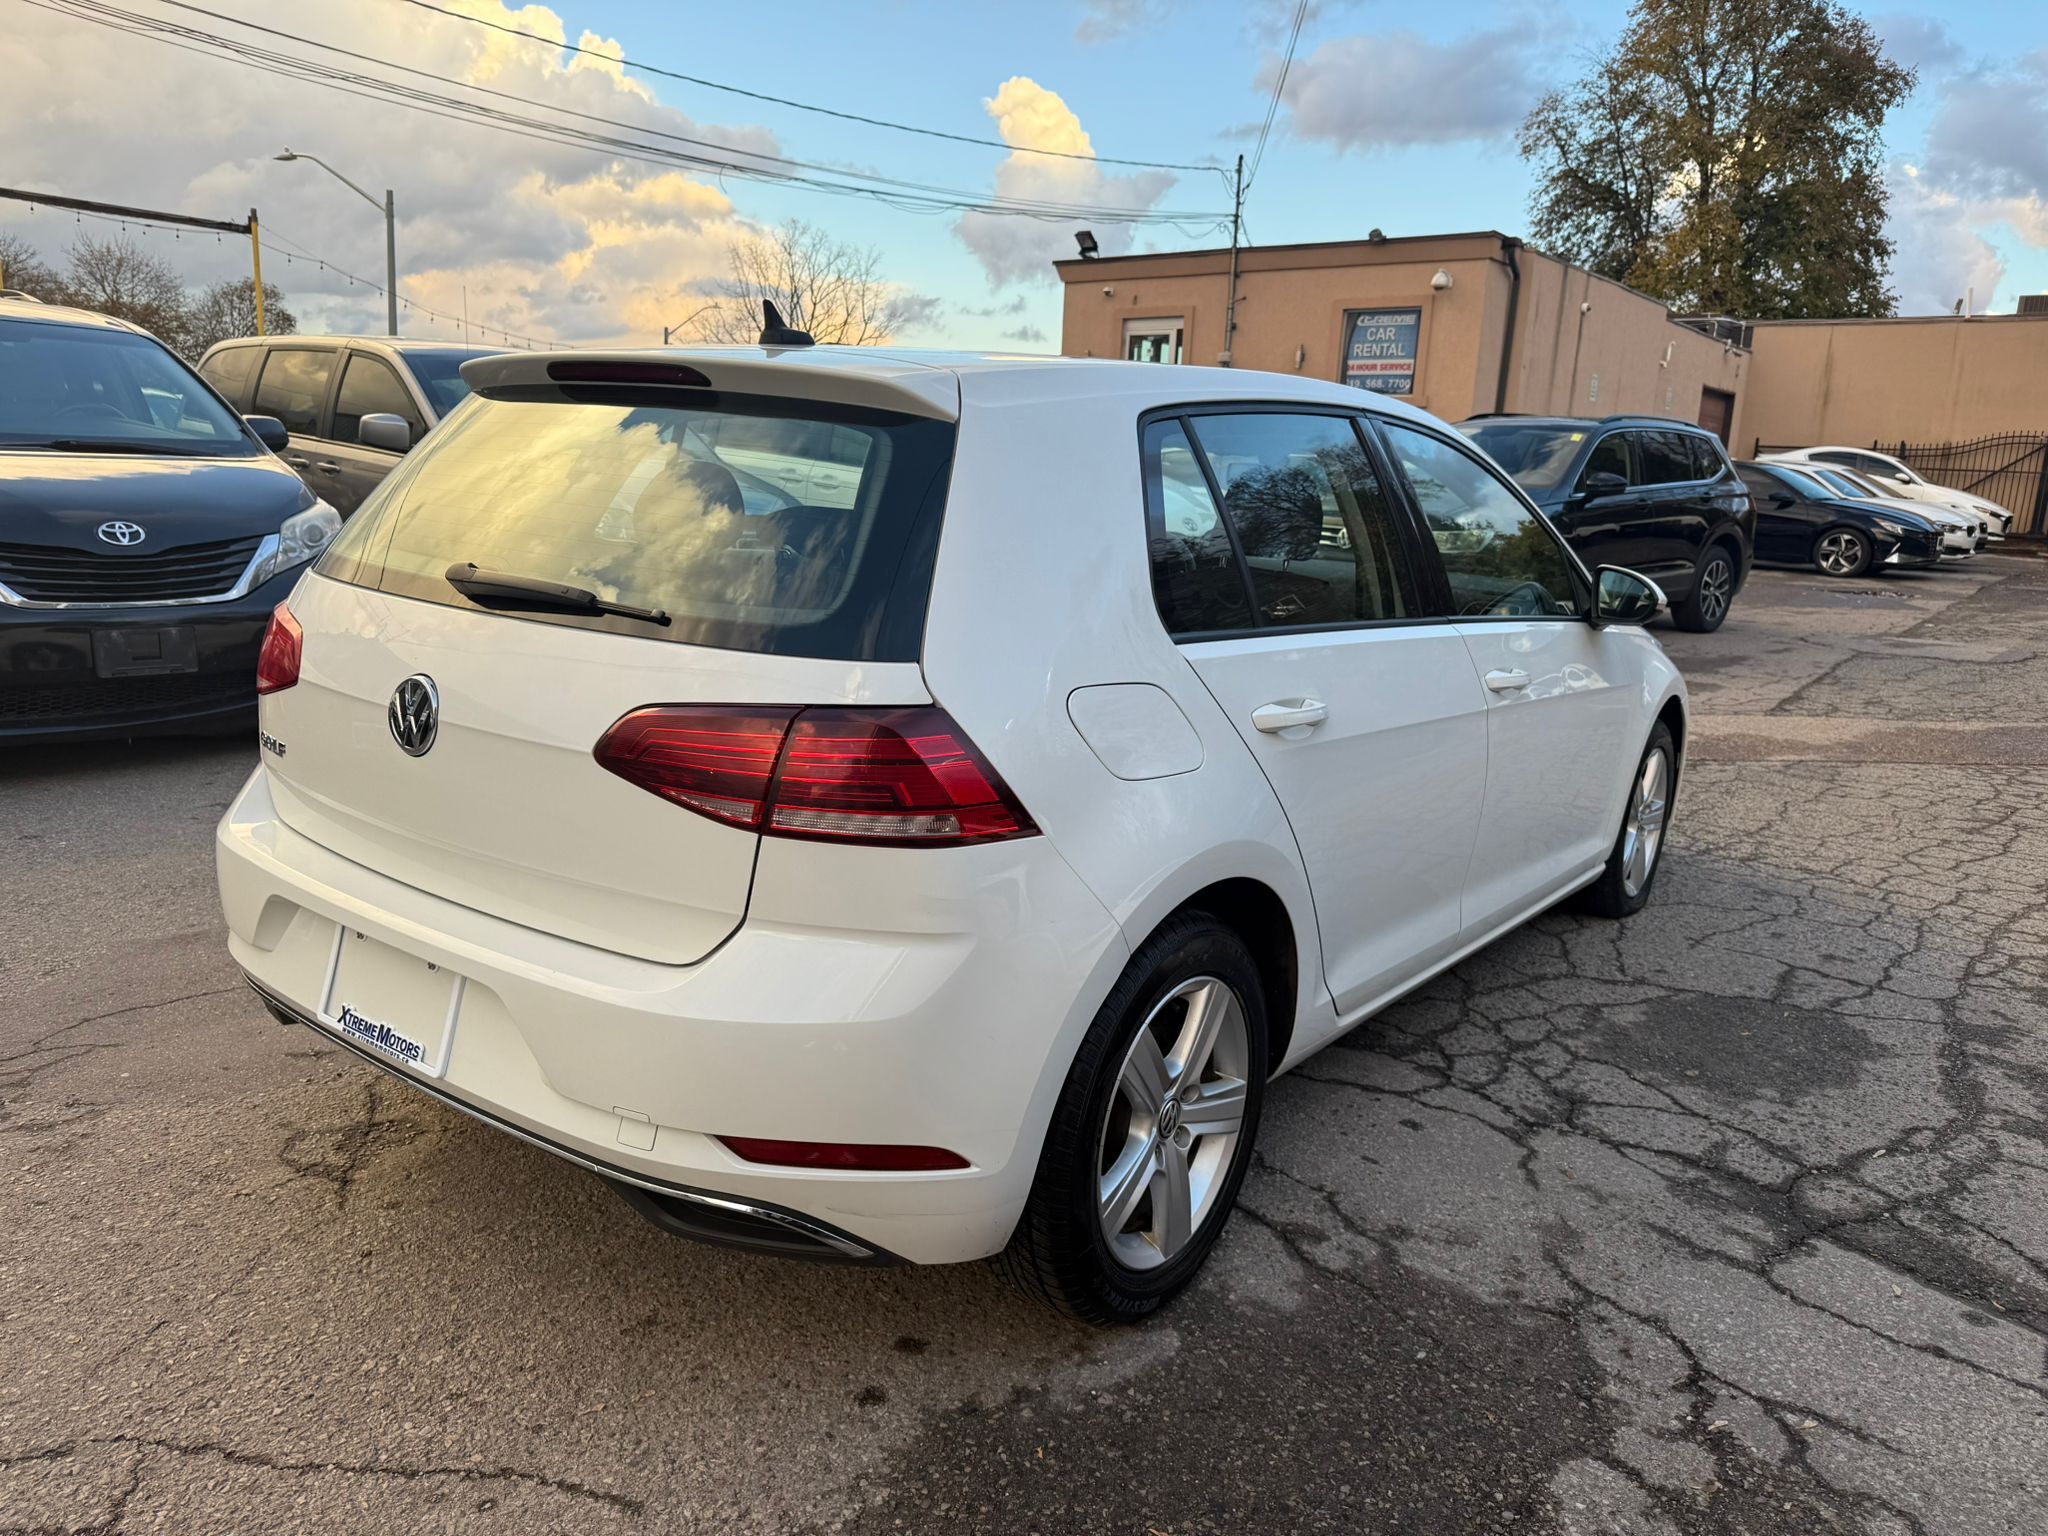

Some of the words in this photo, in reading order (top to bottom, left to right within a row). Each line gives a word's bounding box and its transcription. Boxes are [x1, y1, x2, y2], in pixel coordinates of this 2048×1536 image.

[1367, 328, 1395, 340] CAR
[1353, 343, 1406, 357] RENTAL
[1380, 363, 1412, 371] SERVICE
